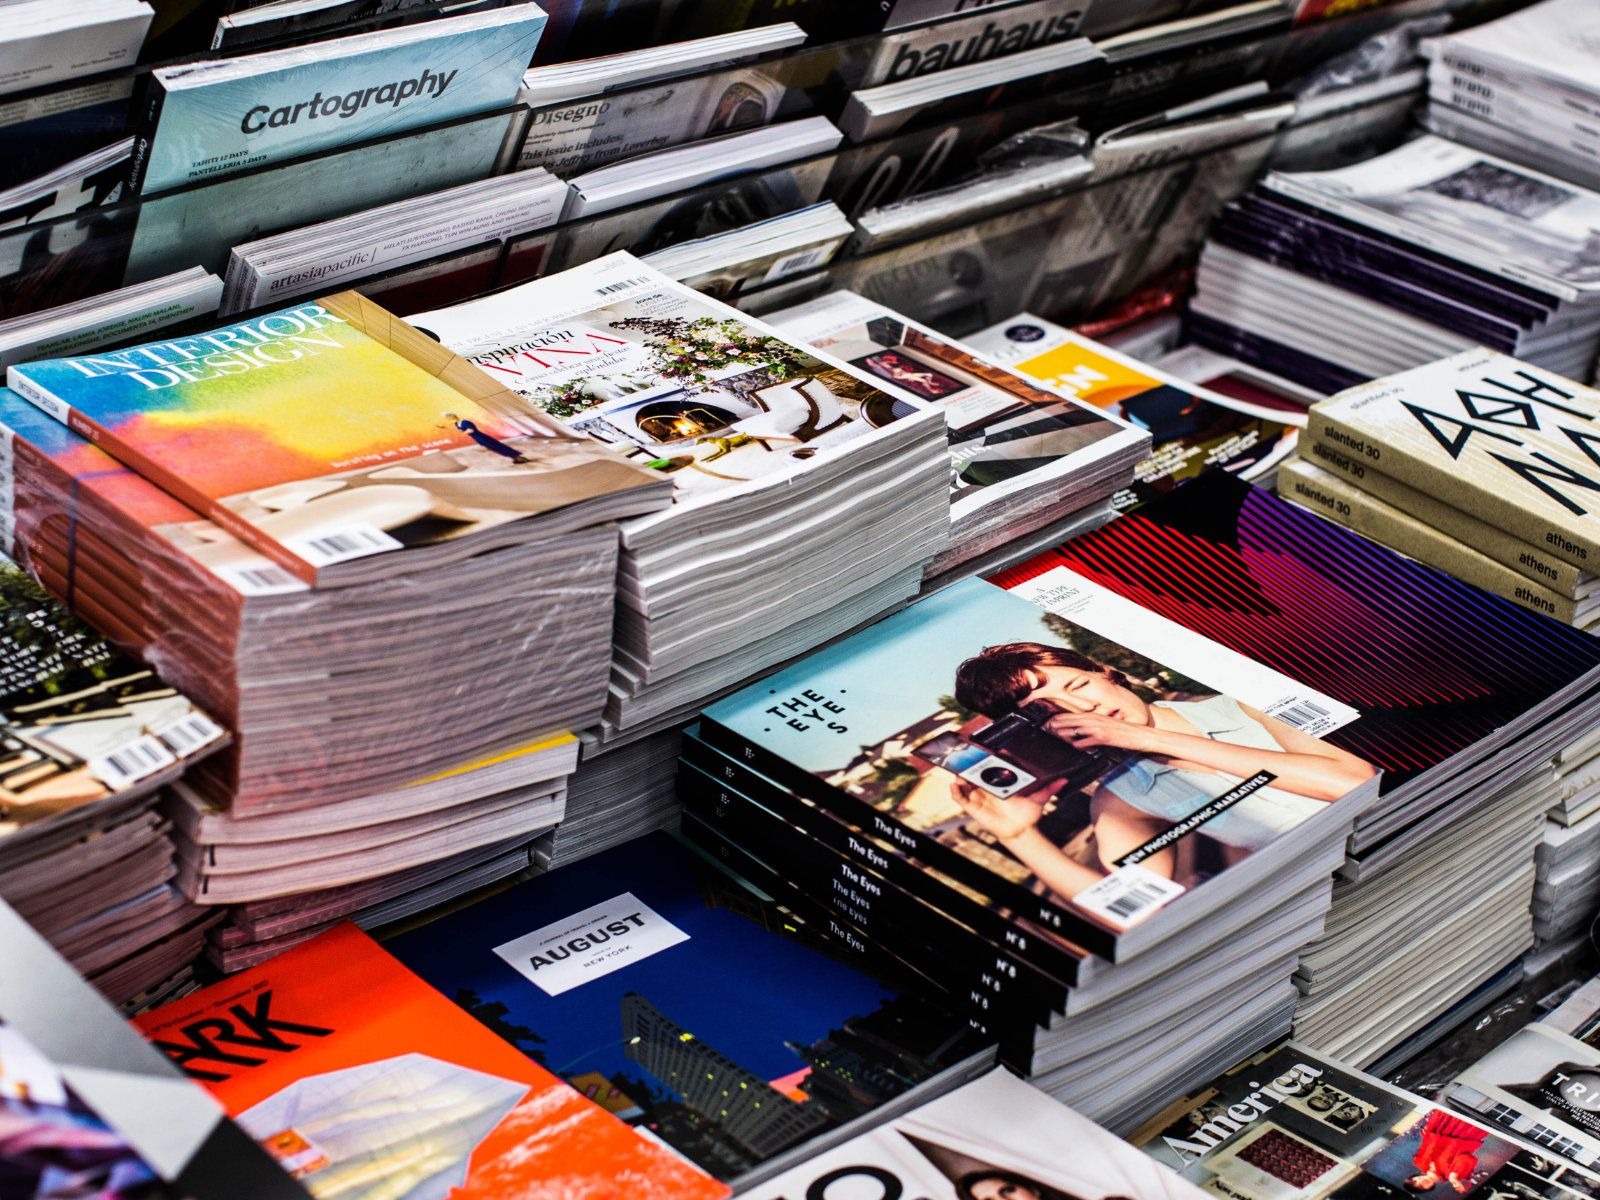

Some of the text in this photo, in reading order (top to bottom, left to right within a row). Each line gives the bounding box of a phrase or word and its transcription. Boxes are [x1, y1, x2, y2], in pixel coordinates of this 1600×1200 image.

[889, 9, 1084, 80] bauhaus
[241, 68, 459, 134] Cartography
[532, 102, 610, 125] Disegno
[545, 142, 574, 157] issue
[594, 145, 620, 159] from
[270, 252, 369, 290] artasiapacific
[64, 305, 348, 378] INTERIOR
[466, 329, 575, 364] nspiración
[481, 332, 629, 376] VINA
[121, 328, 345, 391] DESIGN
[1324, 426, 1380, 460] slanted 30
[1312, 444, 1365, 479] slanted 30
[1295, 483, 1351, 516] slanted 30
[1546, 532, 1588, 560] athens
[1519, 553, 1558, 581] athens
[1514, 587, 1556, 614] athens
[765, 689, 825, 721] THE
[1144, 807, 1217, 853] PHOTOGRAPHIC
[1214, 774, 1269, 810] NARRATIVES
[874, 816, 917, 849] The Eyes
[848, 837, 888, 869] The Eyes
[832, 878, 870, 910] The Eyes
[841, 864, 881, 896] The Eyes
[529, 912, 646, 971] AUGUST
[829, 920, 865, 953] The Eyes
[583, 956, 605, 968] NEW
[605, 944, 633, 958] YORK
[150, 989, 336, 1083] ARK
[1552, 1072, 1600, 1108] TRI
[1156, 1063, 1323, 1174] America
[1581, 1114, 1600, 1127] NATIO
